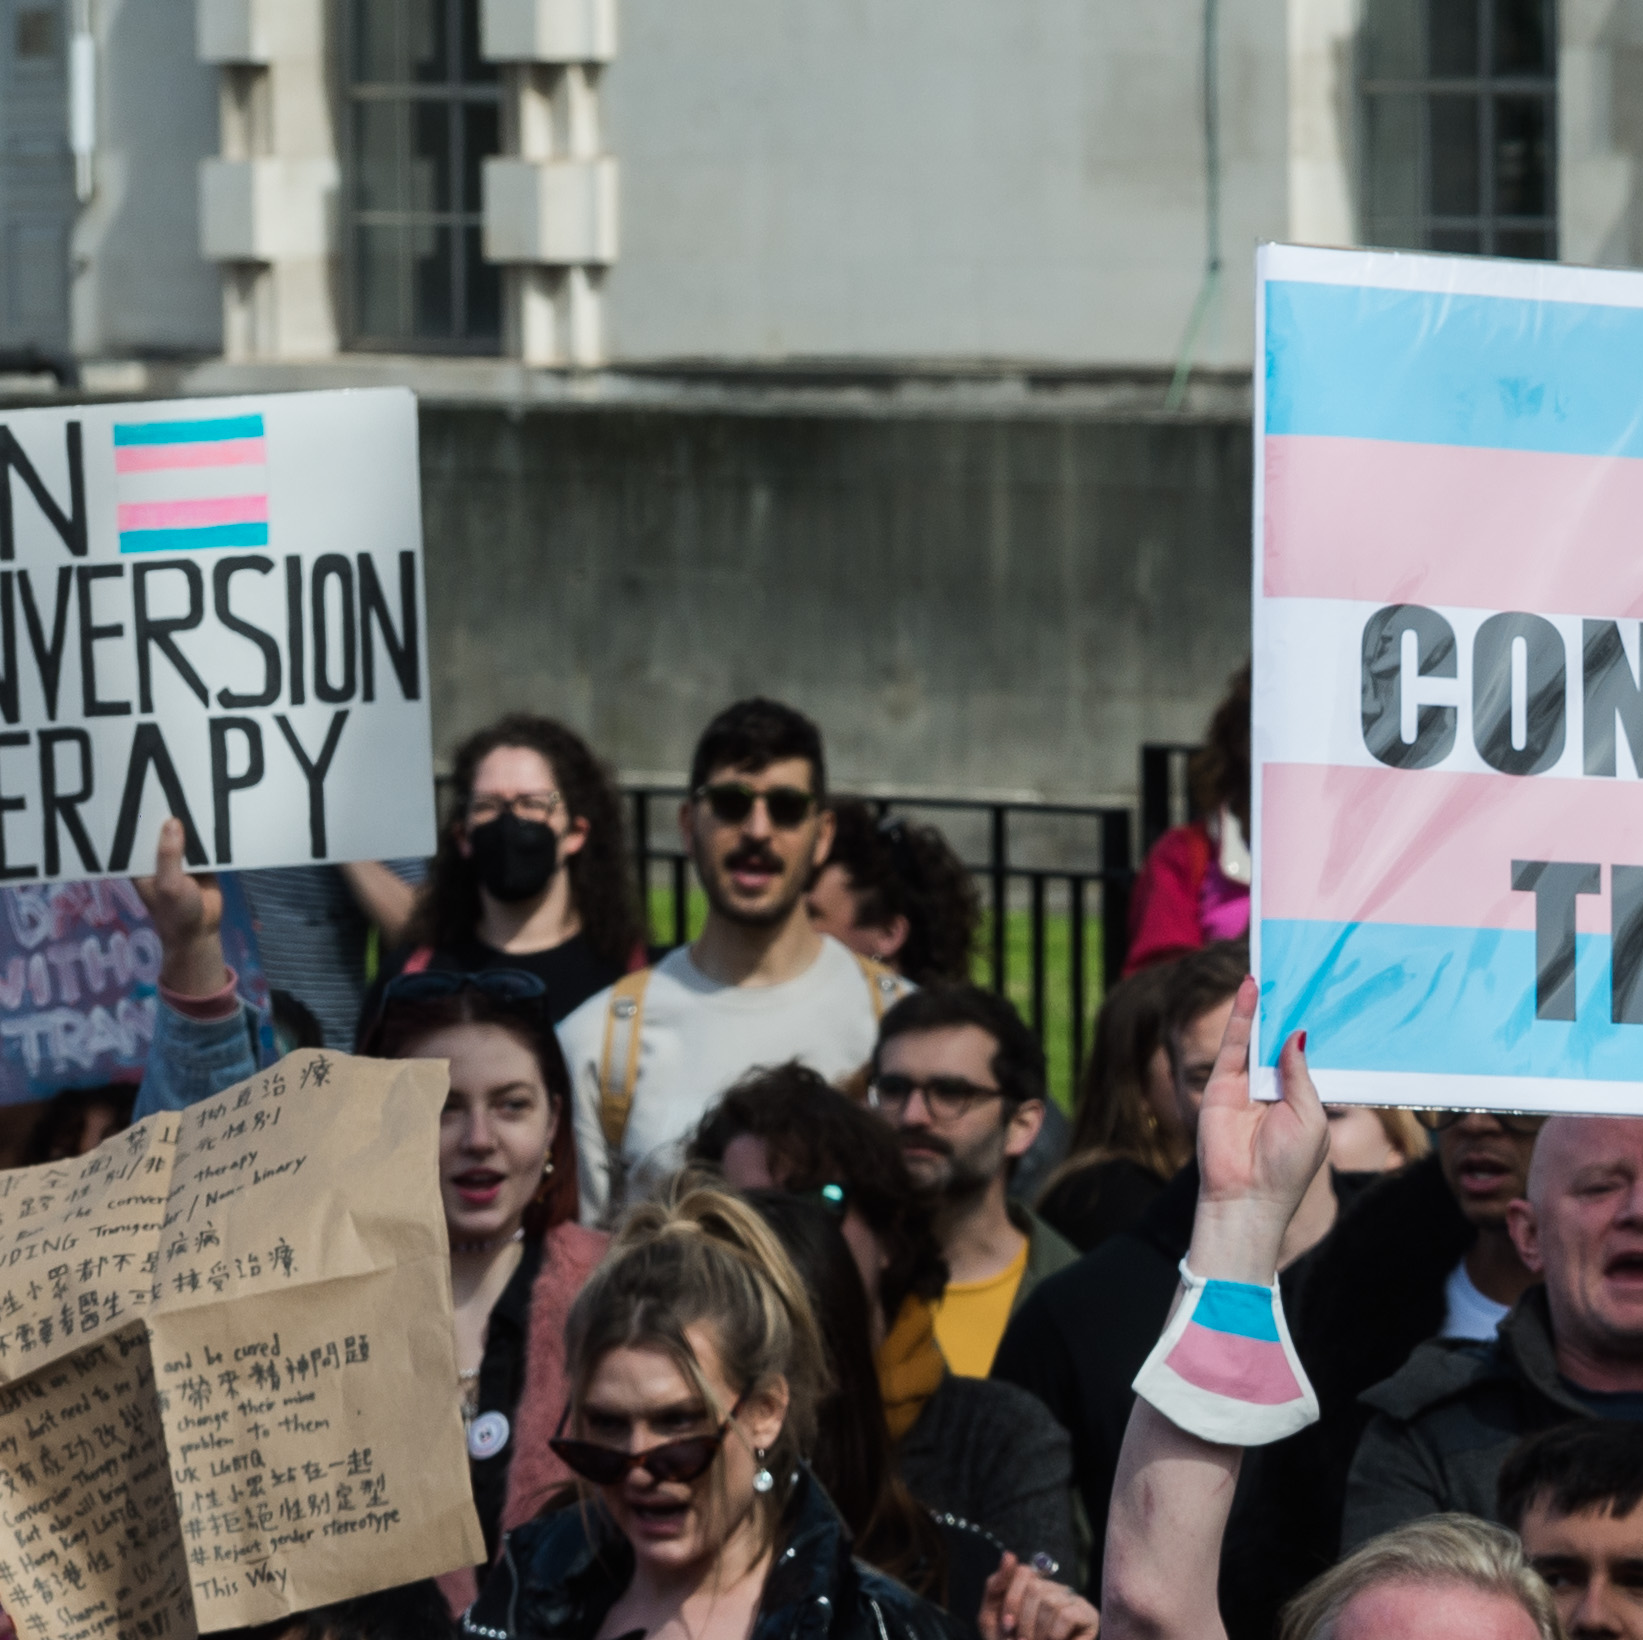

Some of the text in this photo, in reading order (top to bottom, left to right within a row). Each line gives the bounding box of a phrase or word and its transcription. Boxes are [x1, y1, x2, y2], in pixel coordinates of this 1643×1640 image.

[233, 1332, 281, 1362] cured
[277, 1413, 330, 1434] them
[321, 1507, 400, 1537] stereotype
[196, 1576, 240, 1600] This
[246, 1561, 288, 1593] Way
